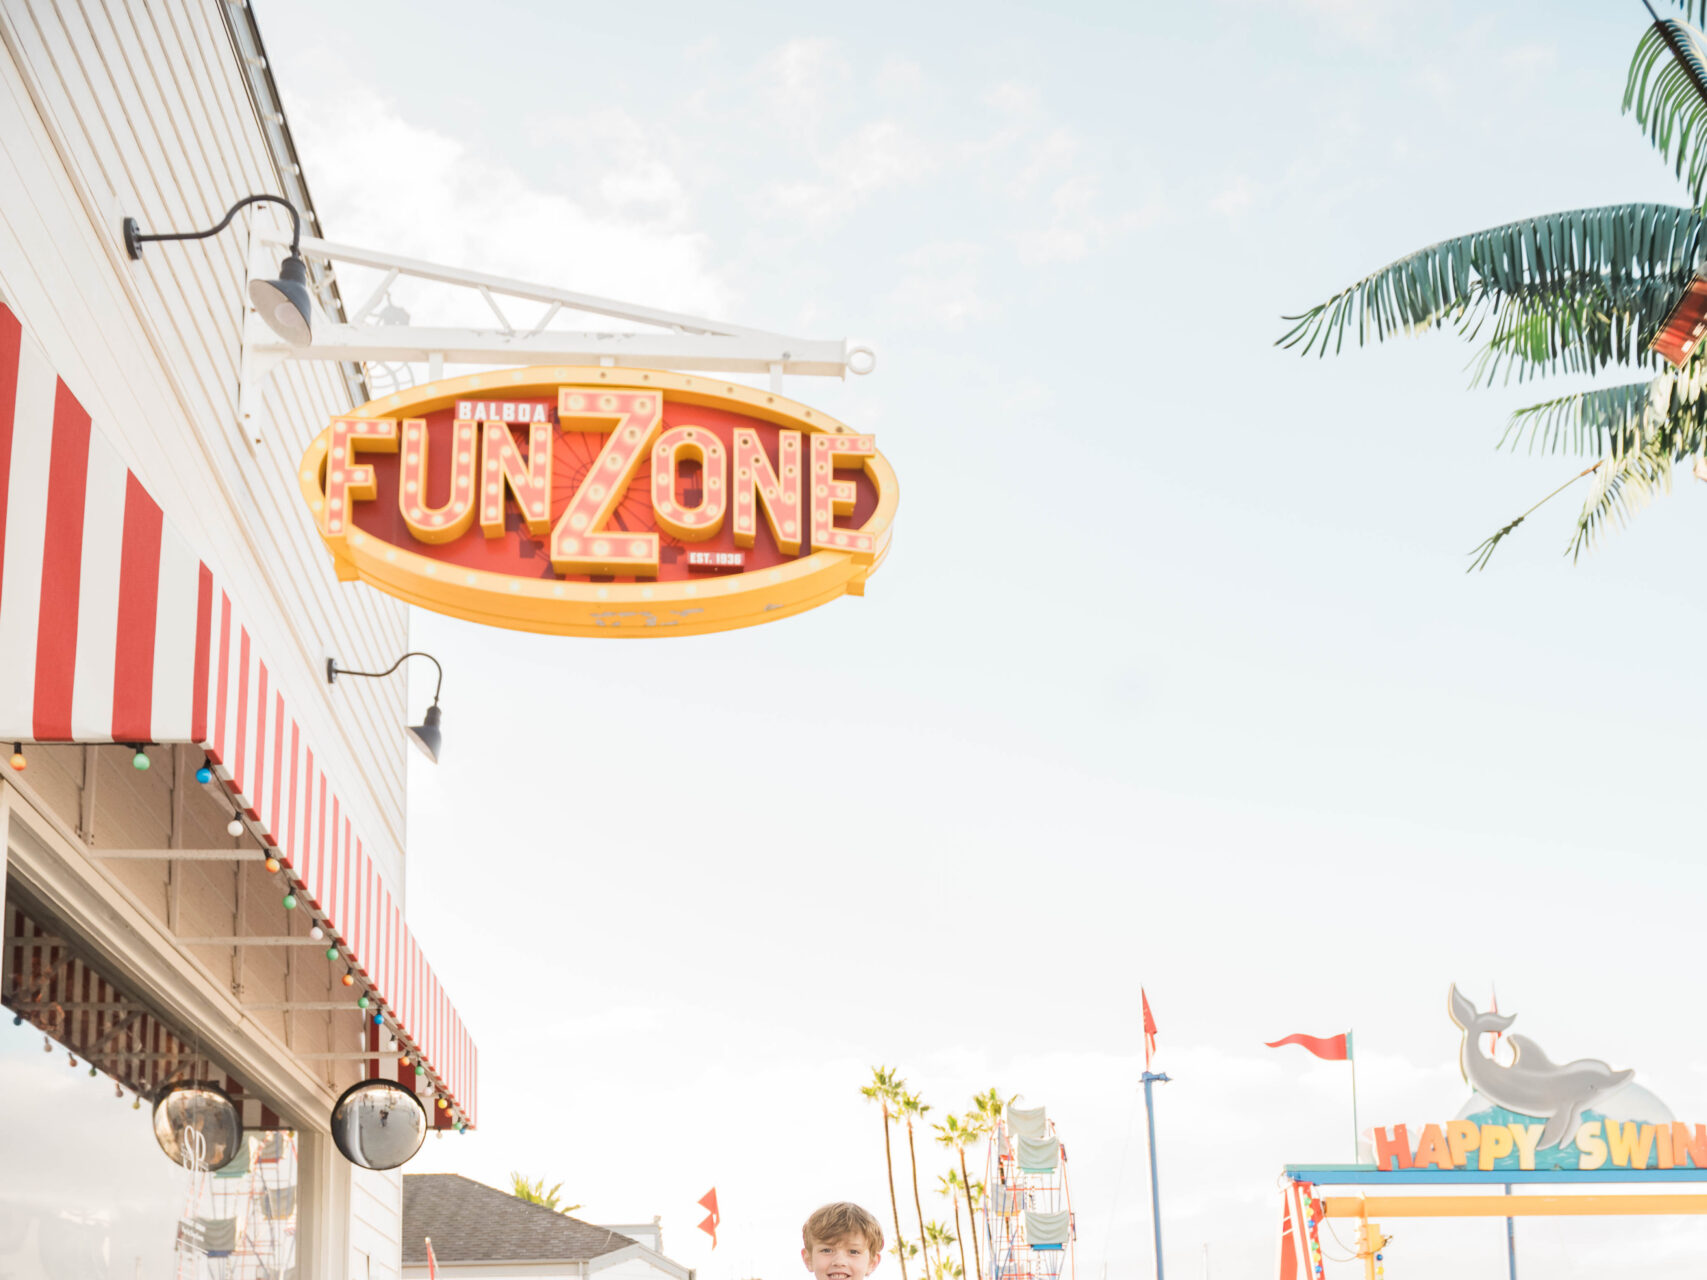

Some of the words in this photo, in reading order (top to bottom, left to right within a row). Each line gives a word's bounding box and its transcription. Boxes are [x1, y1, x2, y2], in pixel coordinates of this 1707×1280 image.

[459, 402, 545, 422] BALBOA
[689, 552, 713, 565] EST.
[1374, 1120, 1545, 1171] HAPPY
